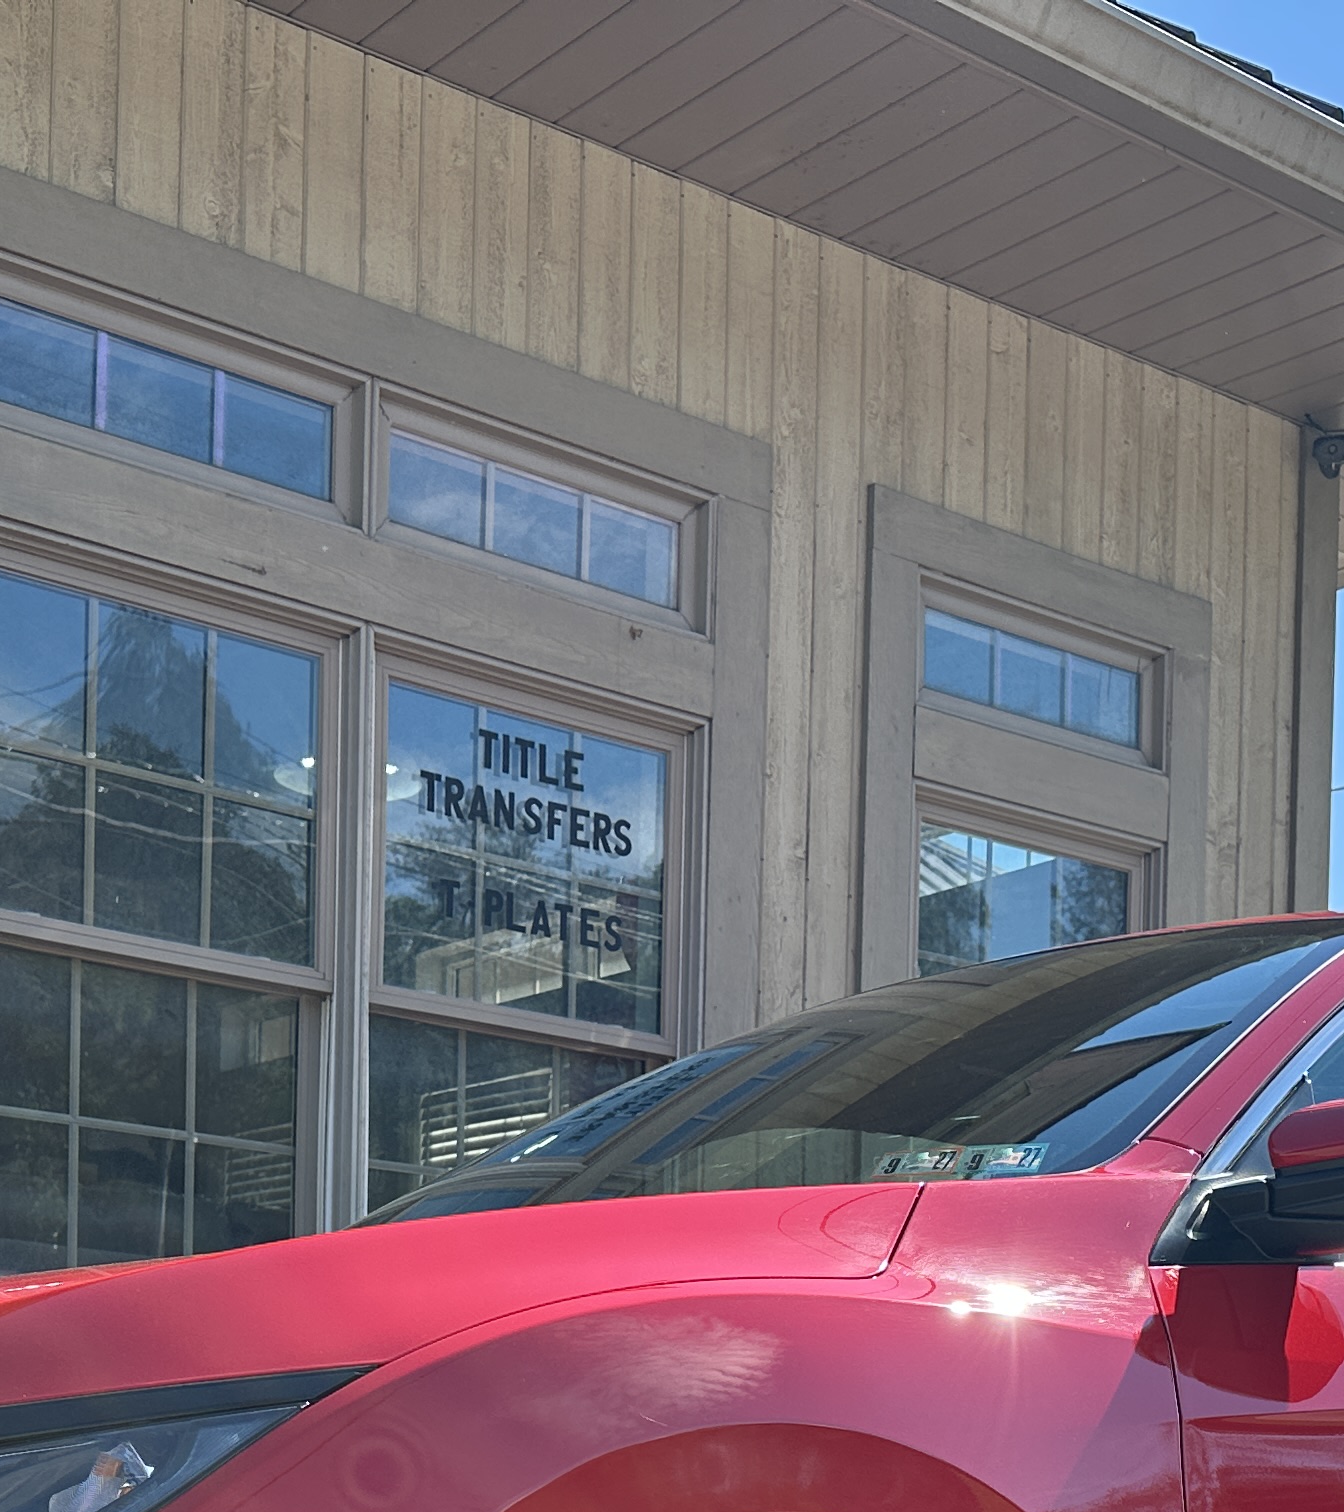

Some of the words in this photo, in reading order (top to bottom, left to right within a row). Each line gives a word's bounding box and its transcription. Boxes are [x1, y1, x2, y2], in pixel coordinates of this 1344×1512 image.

[479, 728, 585, 792] TITLE
[419, 769, 633, 857] TRANSFERS
[484, 888, 623, 952] PLATES
[931, 1150, 958, 1171] 27
[1017, 1147, 1043, 1169] 27
